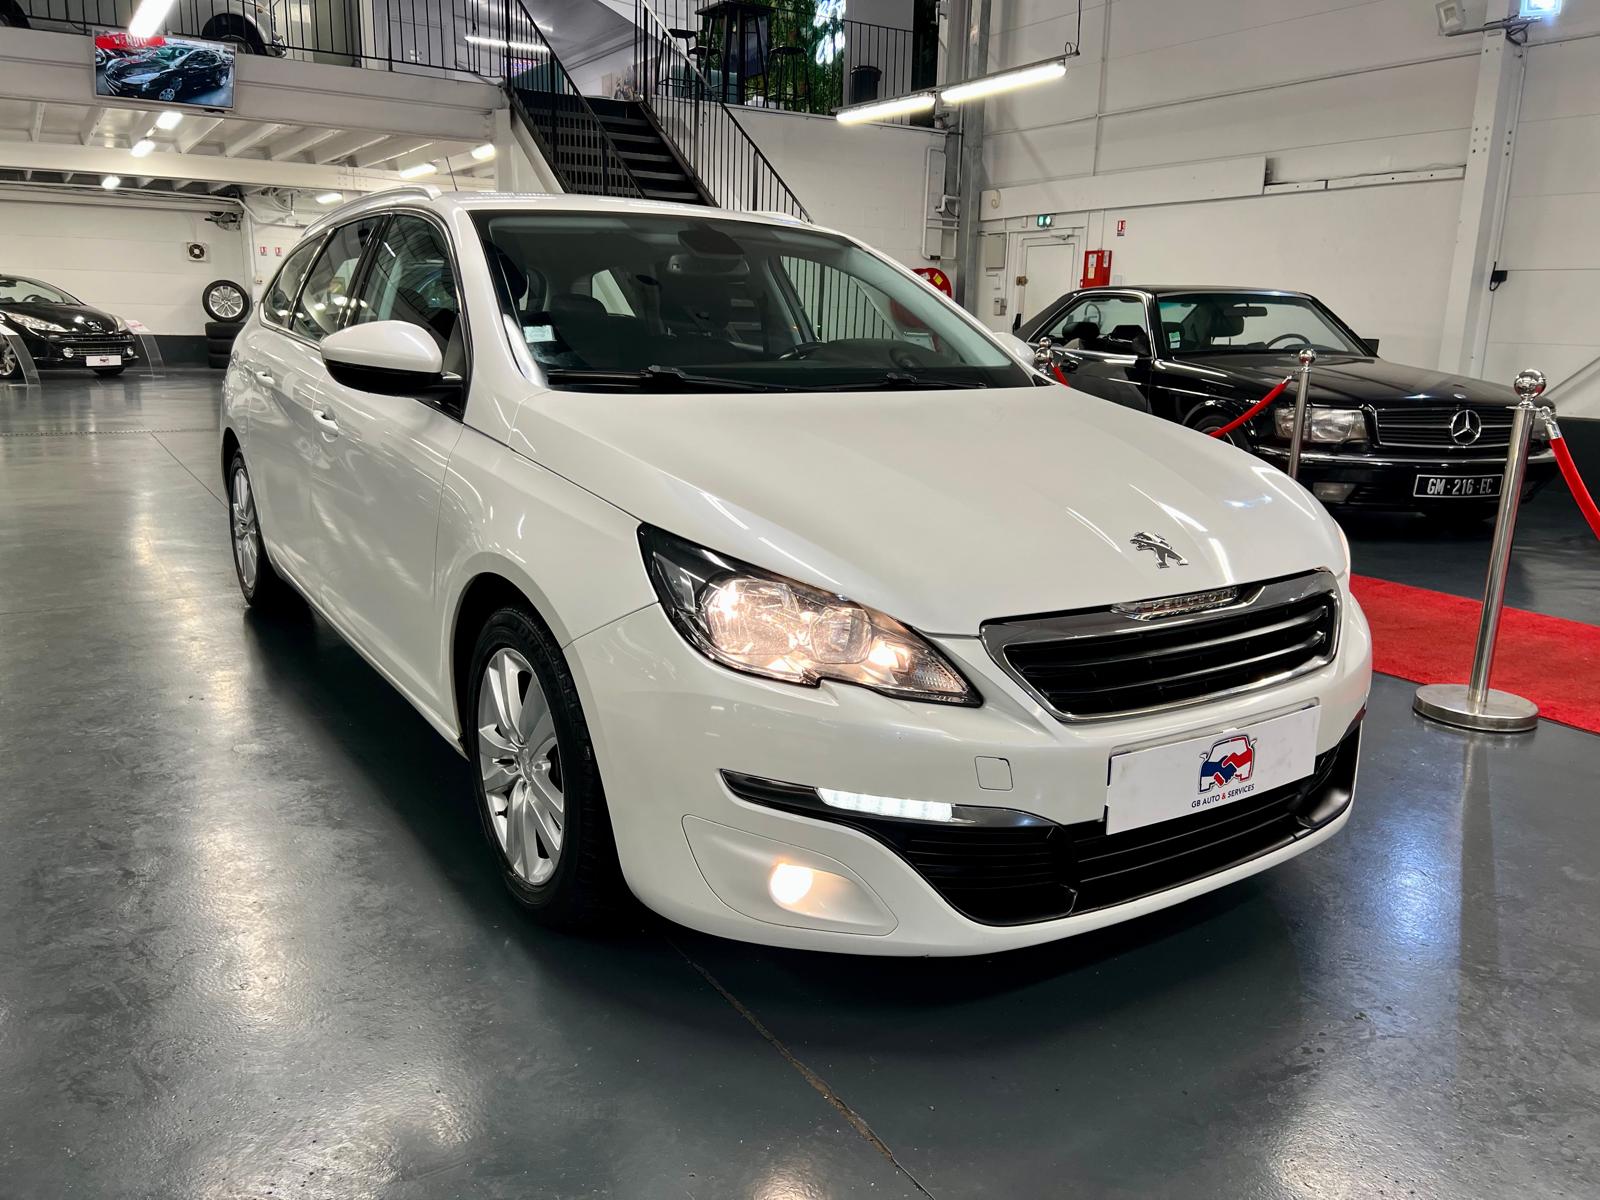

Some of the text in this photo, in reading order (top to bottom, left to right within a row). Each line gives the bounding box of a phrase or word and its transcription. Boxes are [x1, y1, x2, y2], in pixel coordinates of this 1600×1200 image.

[1191, 783, 1255, 809] GB AUTO & SERVICES
